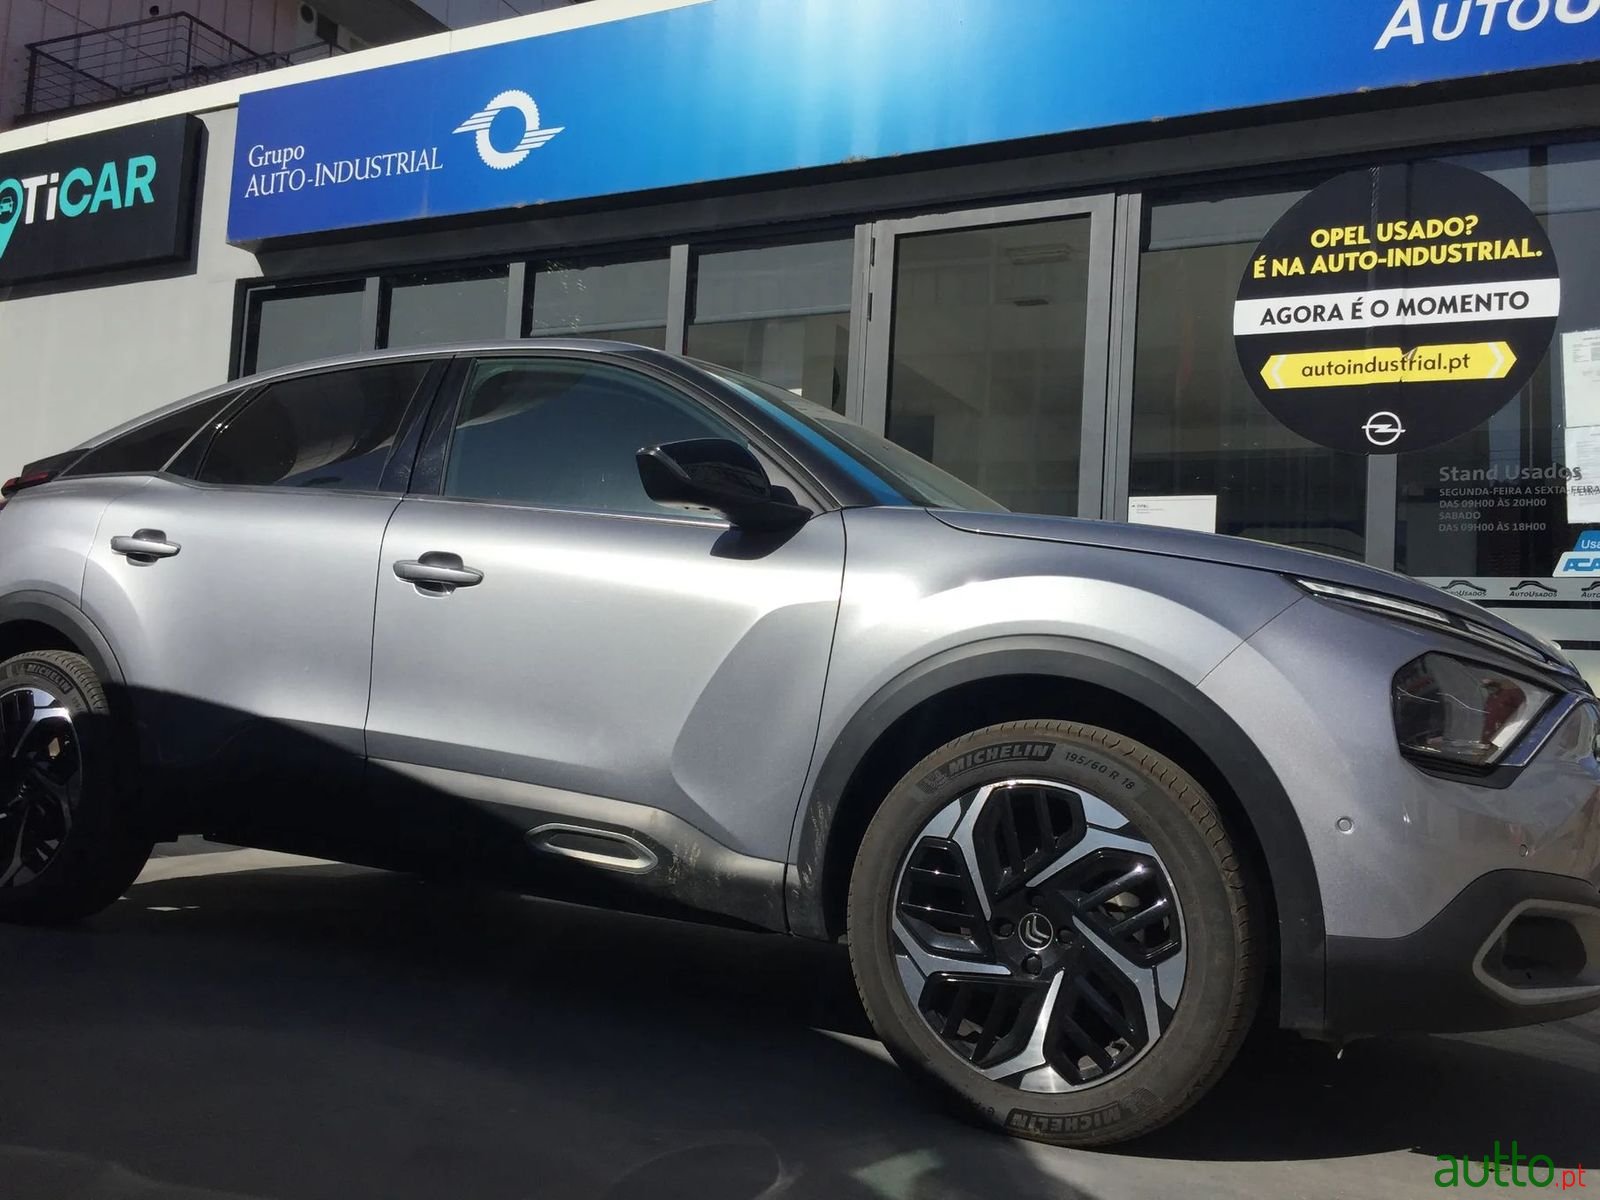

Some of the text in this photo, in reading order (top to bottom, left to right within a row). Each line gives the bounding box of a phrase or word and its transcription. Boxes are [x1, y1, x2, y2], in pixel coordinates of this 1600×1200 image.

[248, 145, 305, 169] Grupo
[244, 147, 444, 198] AUTO-INDUSTRIAL
[1310, 215, 1479, 249] OPEL USADO?
[1253, 238, 1543, 279] É NA AUTO-INDUSTRIAL.
[1260, 290, 1530, 326] AGORA É O MOMENTO
[1301, 351, 1470, 377] autoindustrial.pt
[1439, 462, 1582, 482] Stand Usados
[1439, 486, 1523, 497] SEGUNDA-FEIRA
[1525, 486, 1533, 495] A
[1439, 497, 1547, 509] DAS 09H00 ÀS 20H00
[1439, 520, 1547, 532] DAS 09H00 ÀS 18H00
[26, 663, 72, 692] MICHELIN
[949, 743, 1051, 776] MICHELIN
[1065, 751, 1136, 790] 195/60 R 18
[1011, 1103, 1122, 1131] MICHELIN
